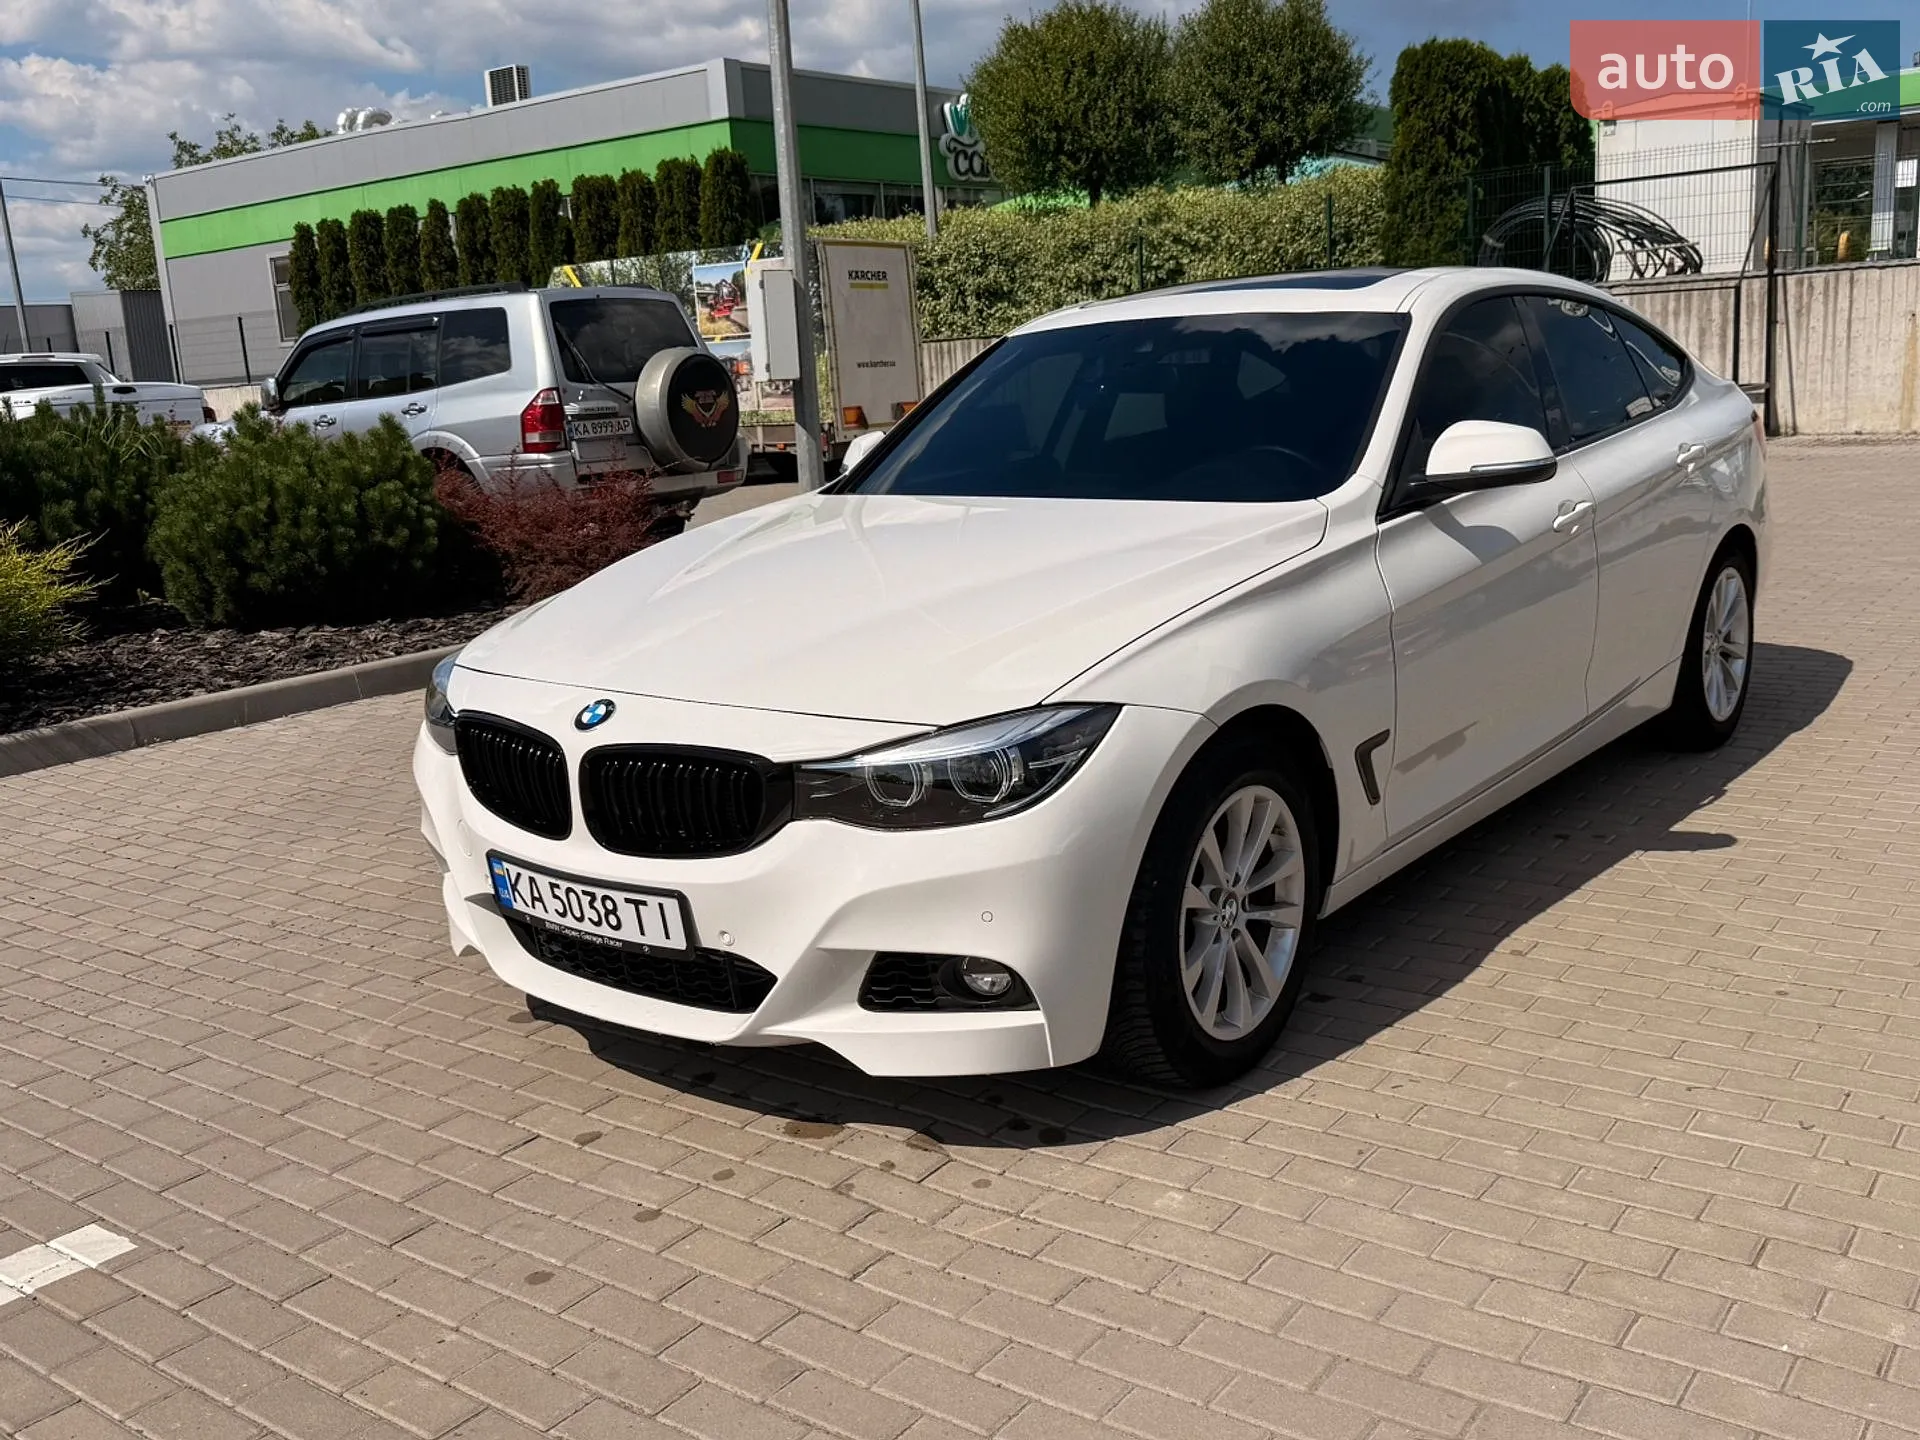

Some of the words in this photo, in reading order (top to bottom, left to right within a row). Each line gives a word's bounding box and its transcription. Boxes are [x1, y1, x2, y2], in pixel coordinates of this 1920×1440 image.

[573, 423, 590, 436] KA
[591, 420, 614, 434] 8999
[616, 419, 631, 432] AP
[505, 867, 549, 914] KA
[548, 881, 622, 931] 5038
[624, 897, 671, 940] TI
